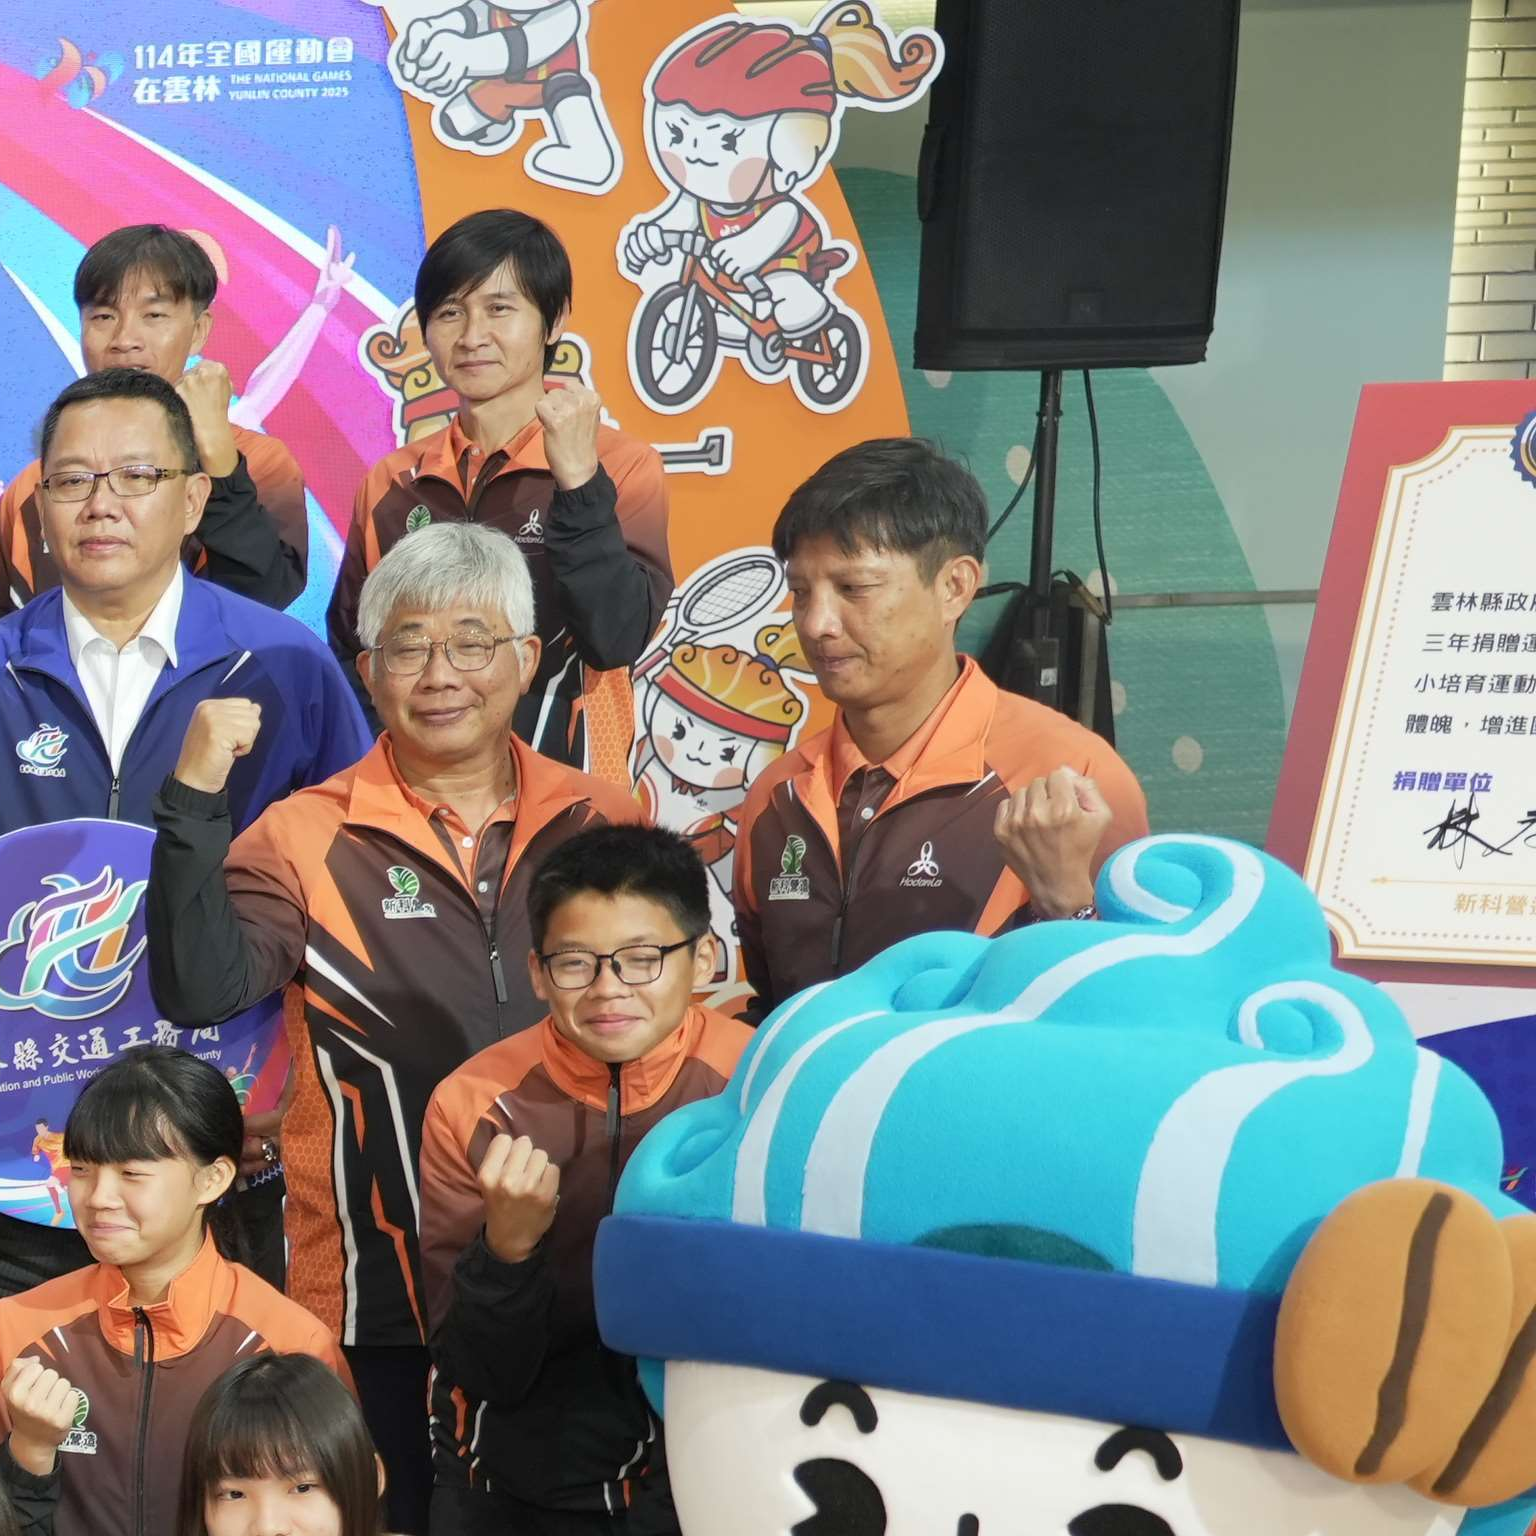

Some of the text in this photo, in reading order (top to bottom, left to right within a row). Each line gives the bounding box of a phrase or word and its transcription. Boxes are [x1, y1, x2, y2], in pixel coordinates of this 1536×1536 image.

[134, 37, 354, 69] 114年全國運動會
[231, 70, 353, 84] THE NATIONAL GAMES
[133, 75, 222, 105] 在雲林
[229, 87, 349, 100] YUNLIN COUNTY 2025
[1405, 713, 1536, 736] 體魄，增進
[1393, 771, 1494, 794] 捐贈單位
[1455, 892, 1536, 916] 新科營
[22, 1077, 41, 1089] and
[43, 1070, 75, 1087] Public
